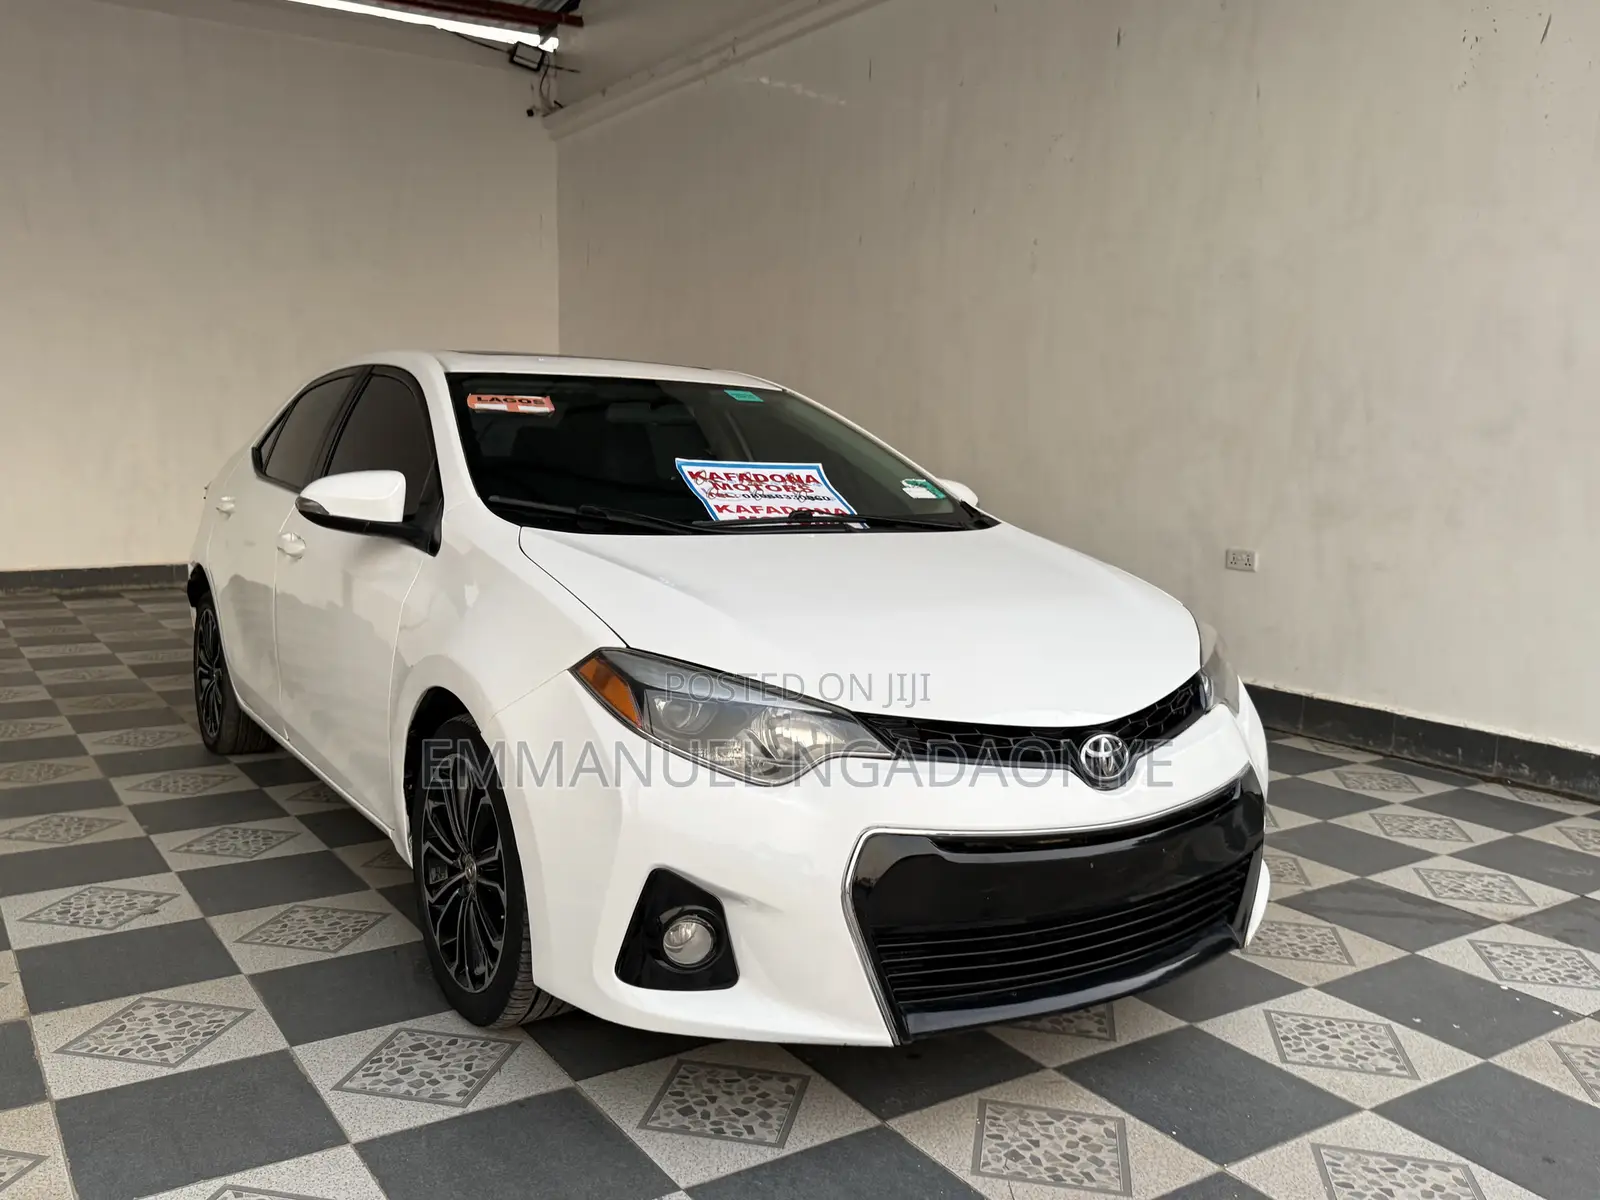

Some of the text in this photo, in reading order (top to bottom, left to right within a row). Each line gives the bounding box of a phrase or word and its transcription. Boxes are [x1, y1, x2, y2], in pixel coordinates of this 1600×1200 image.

[476, 396, 545, 405] LAGOS
[687, 470, 822, 484] KAFADONA
[711, 482, 814, 494] MOTORS
